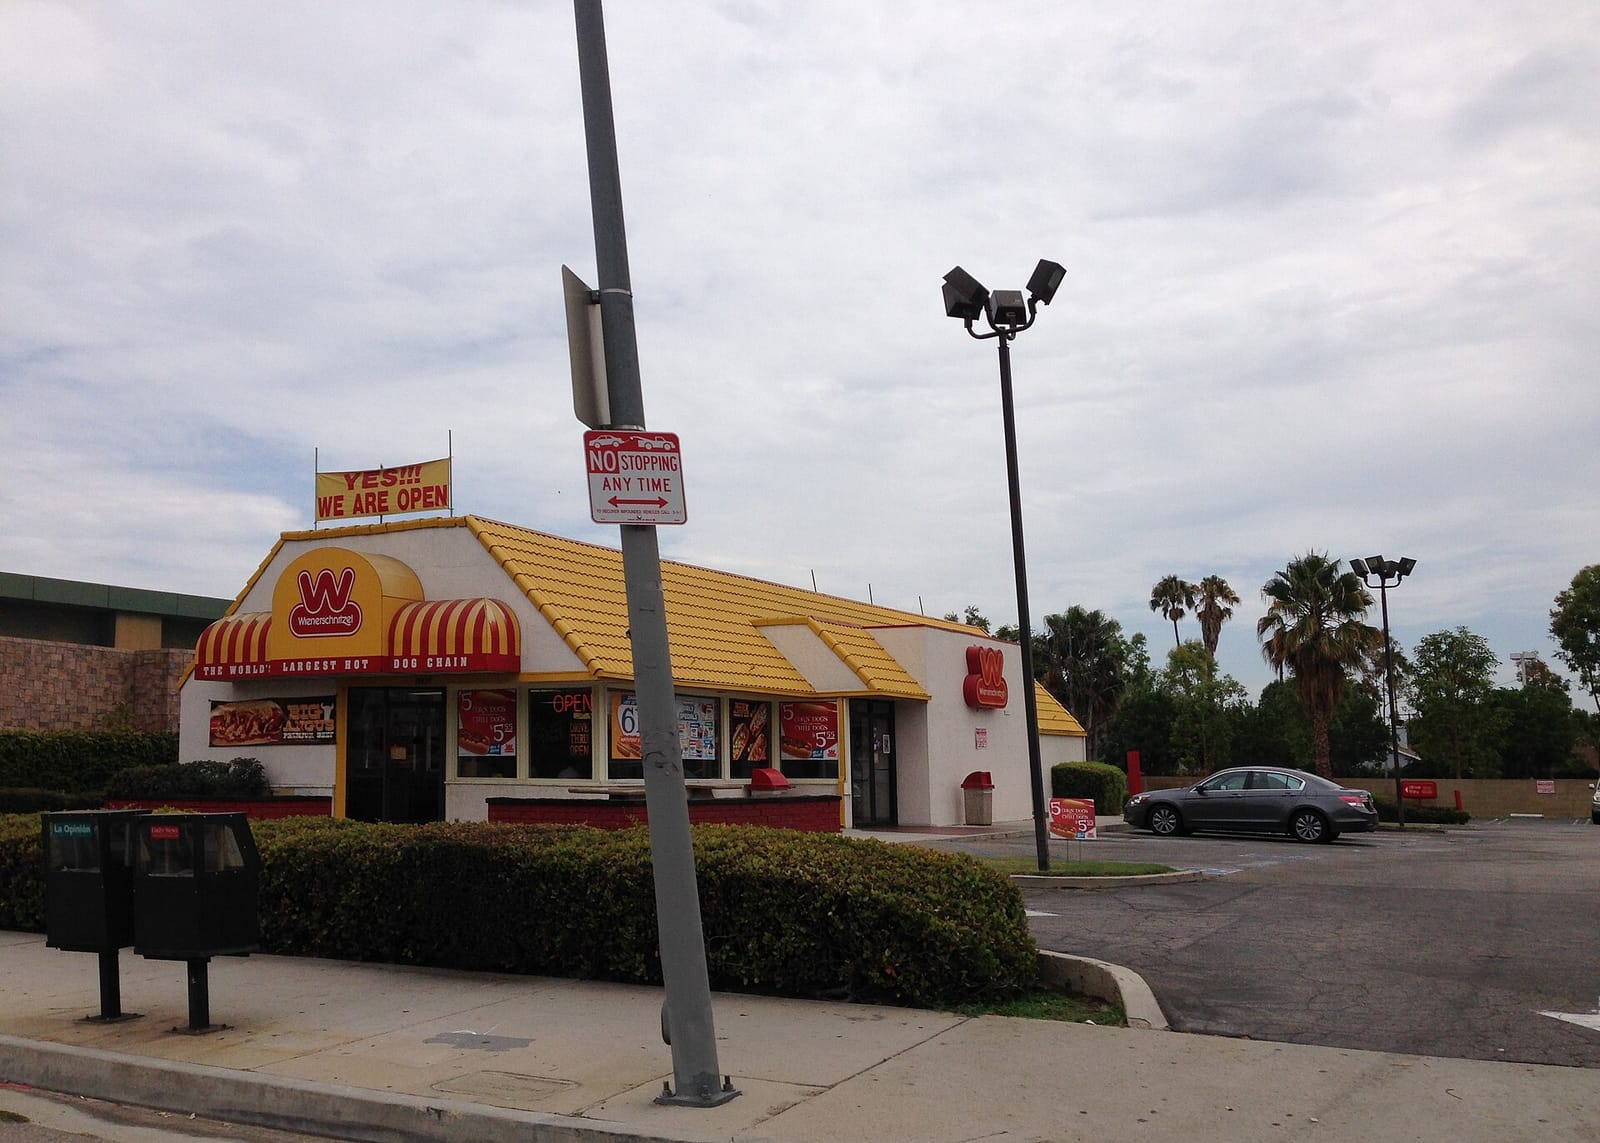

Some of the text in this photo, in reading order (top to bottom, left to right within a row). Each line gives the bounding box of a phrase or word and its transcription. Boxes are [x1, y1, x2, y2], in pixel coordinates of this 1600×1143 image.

[589, 449, 678, 472] NO STOPPING
[343, 464, 422, 491] YES!!!
[602, 476, 672, 492] ANY TIME
[318, 484, 448, 517] WE ARE OPEN
[298, 567, 355, 614] W
[297, 614, 353, 626] Wienerschnitzel
[203, 666, 223, 676] THE
[282, 660, 337, 672] LARGEST
[344, 659, 369, 669] HOT
[393, 658, 417, 669] DOG
[427, 656, 468, 668] CHAIN
[462, 693, 473, 711] 5
[552, 694, 593, 713] OPEN
[287, 703, 321, 720] BIG
[783, 704, 794, 721] 5
[282, 719, 335, 732] ANGUS
[1050, 801, 1061, 816] 5
[54, 823, 91, 836] La Opinión
